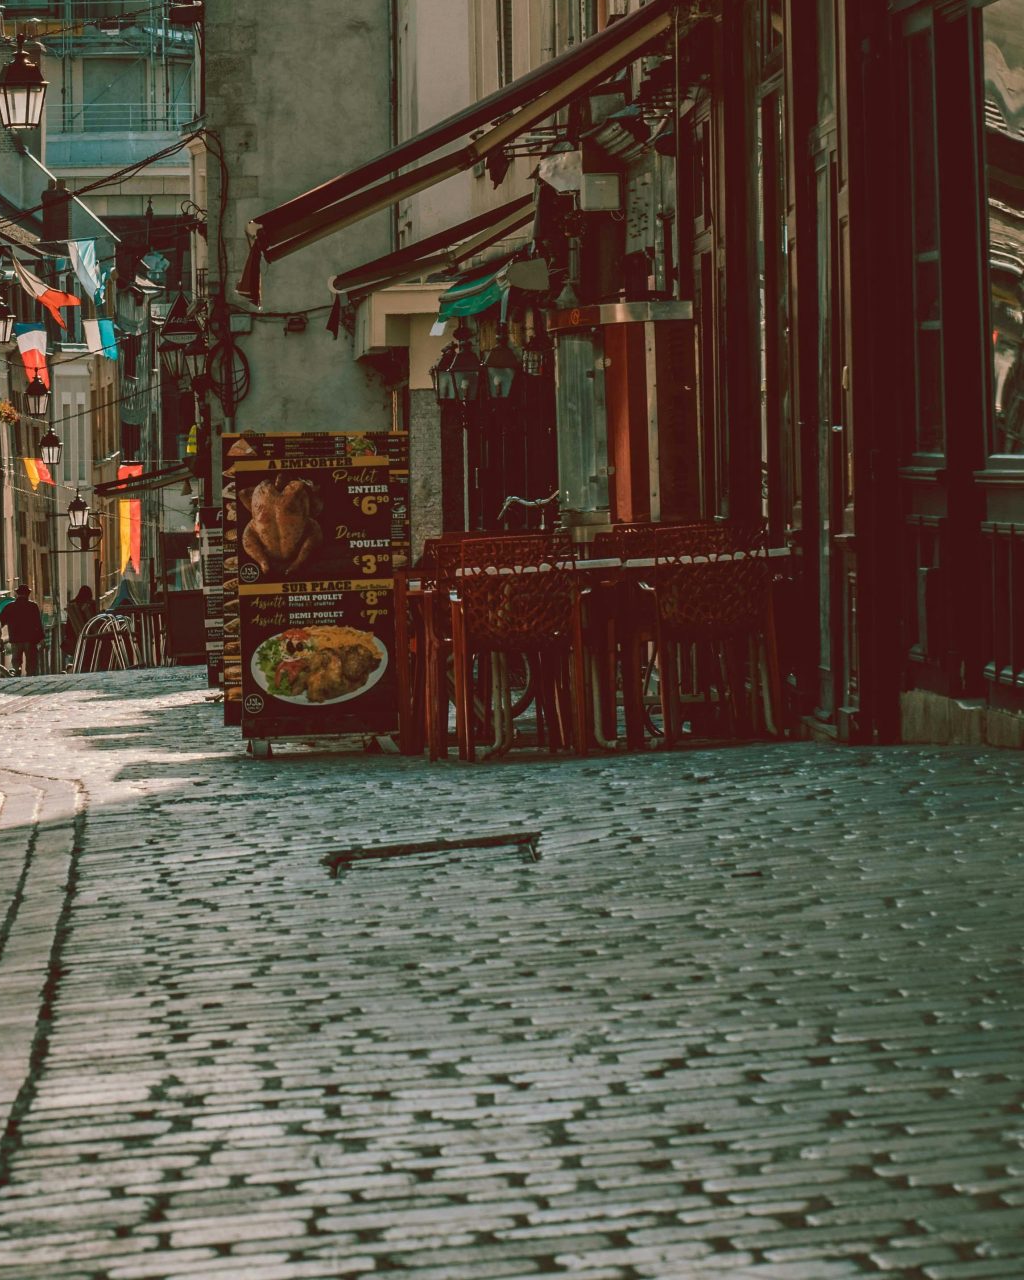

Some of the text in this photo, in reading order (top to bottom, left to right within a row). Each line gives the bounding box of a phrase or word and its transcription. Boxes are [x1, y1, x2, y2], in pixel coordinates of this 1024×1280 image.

[268, 457, 353, 469] A EMPORTER
[332, 468, 378, 484] Poulet
[348, 484, 388, 494] ENTIER
[335, 525, 367, 539] Demi
[349, 539, 391, 549] POULET
[282, 582, 308, 593] SUR
[311, 580, 352, 592] PLACE
[312, 593, 343, 601] POULET
